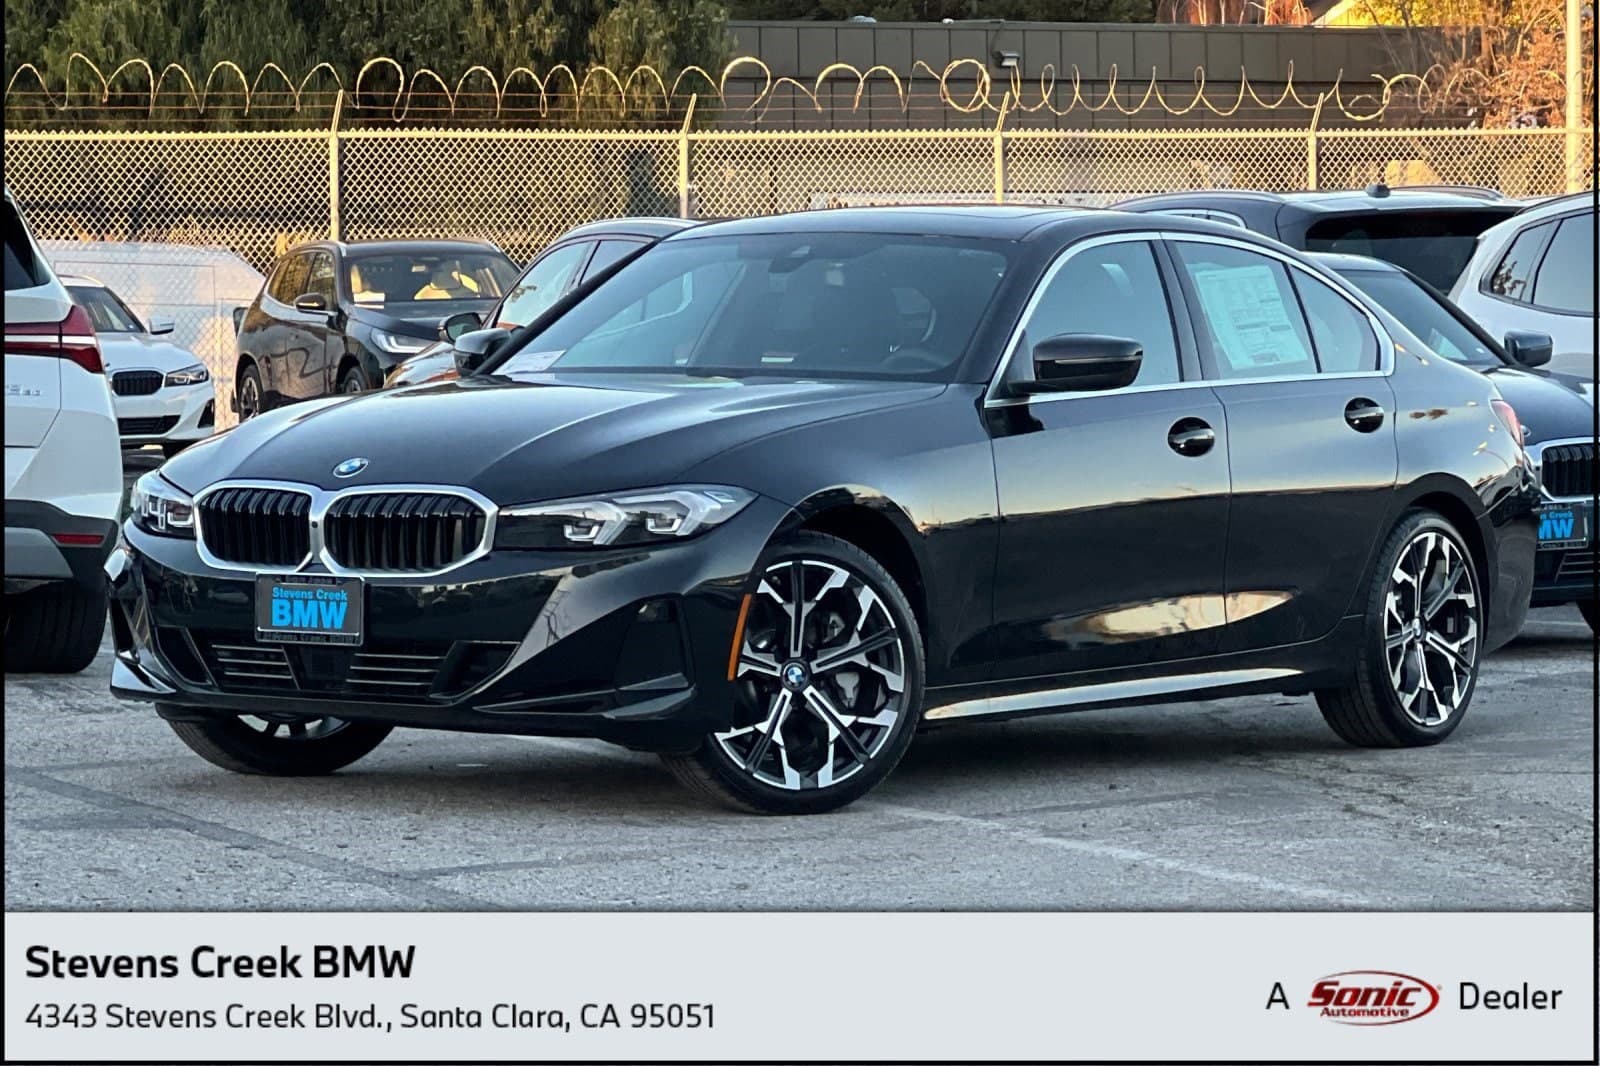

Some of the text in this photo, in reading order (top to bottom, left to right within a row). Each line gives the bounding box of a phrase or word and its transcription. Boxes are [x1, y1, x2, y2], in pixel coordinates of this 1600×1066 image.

[1538, 519, 1574, 539] MW
[272, 586, 348, 600] Stevens Creek
[271, 599, 348, 629] BMW
